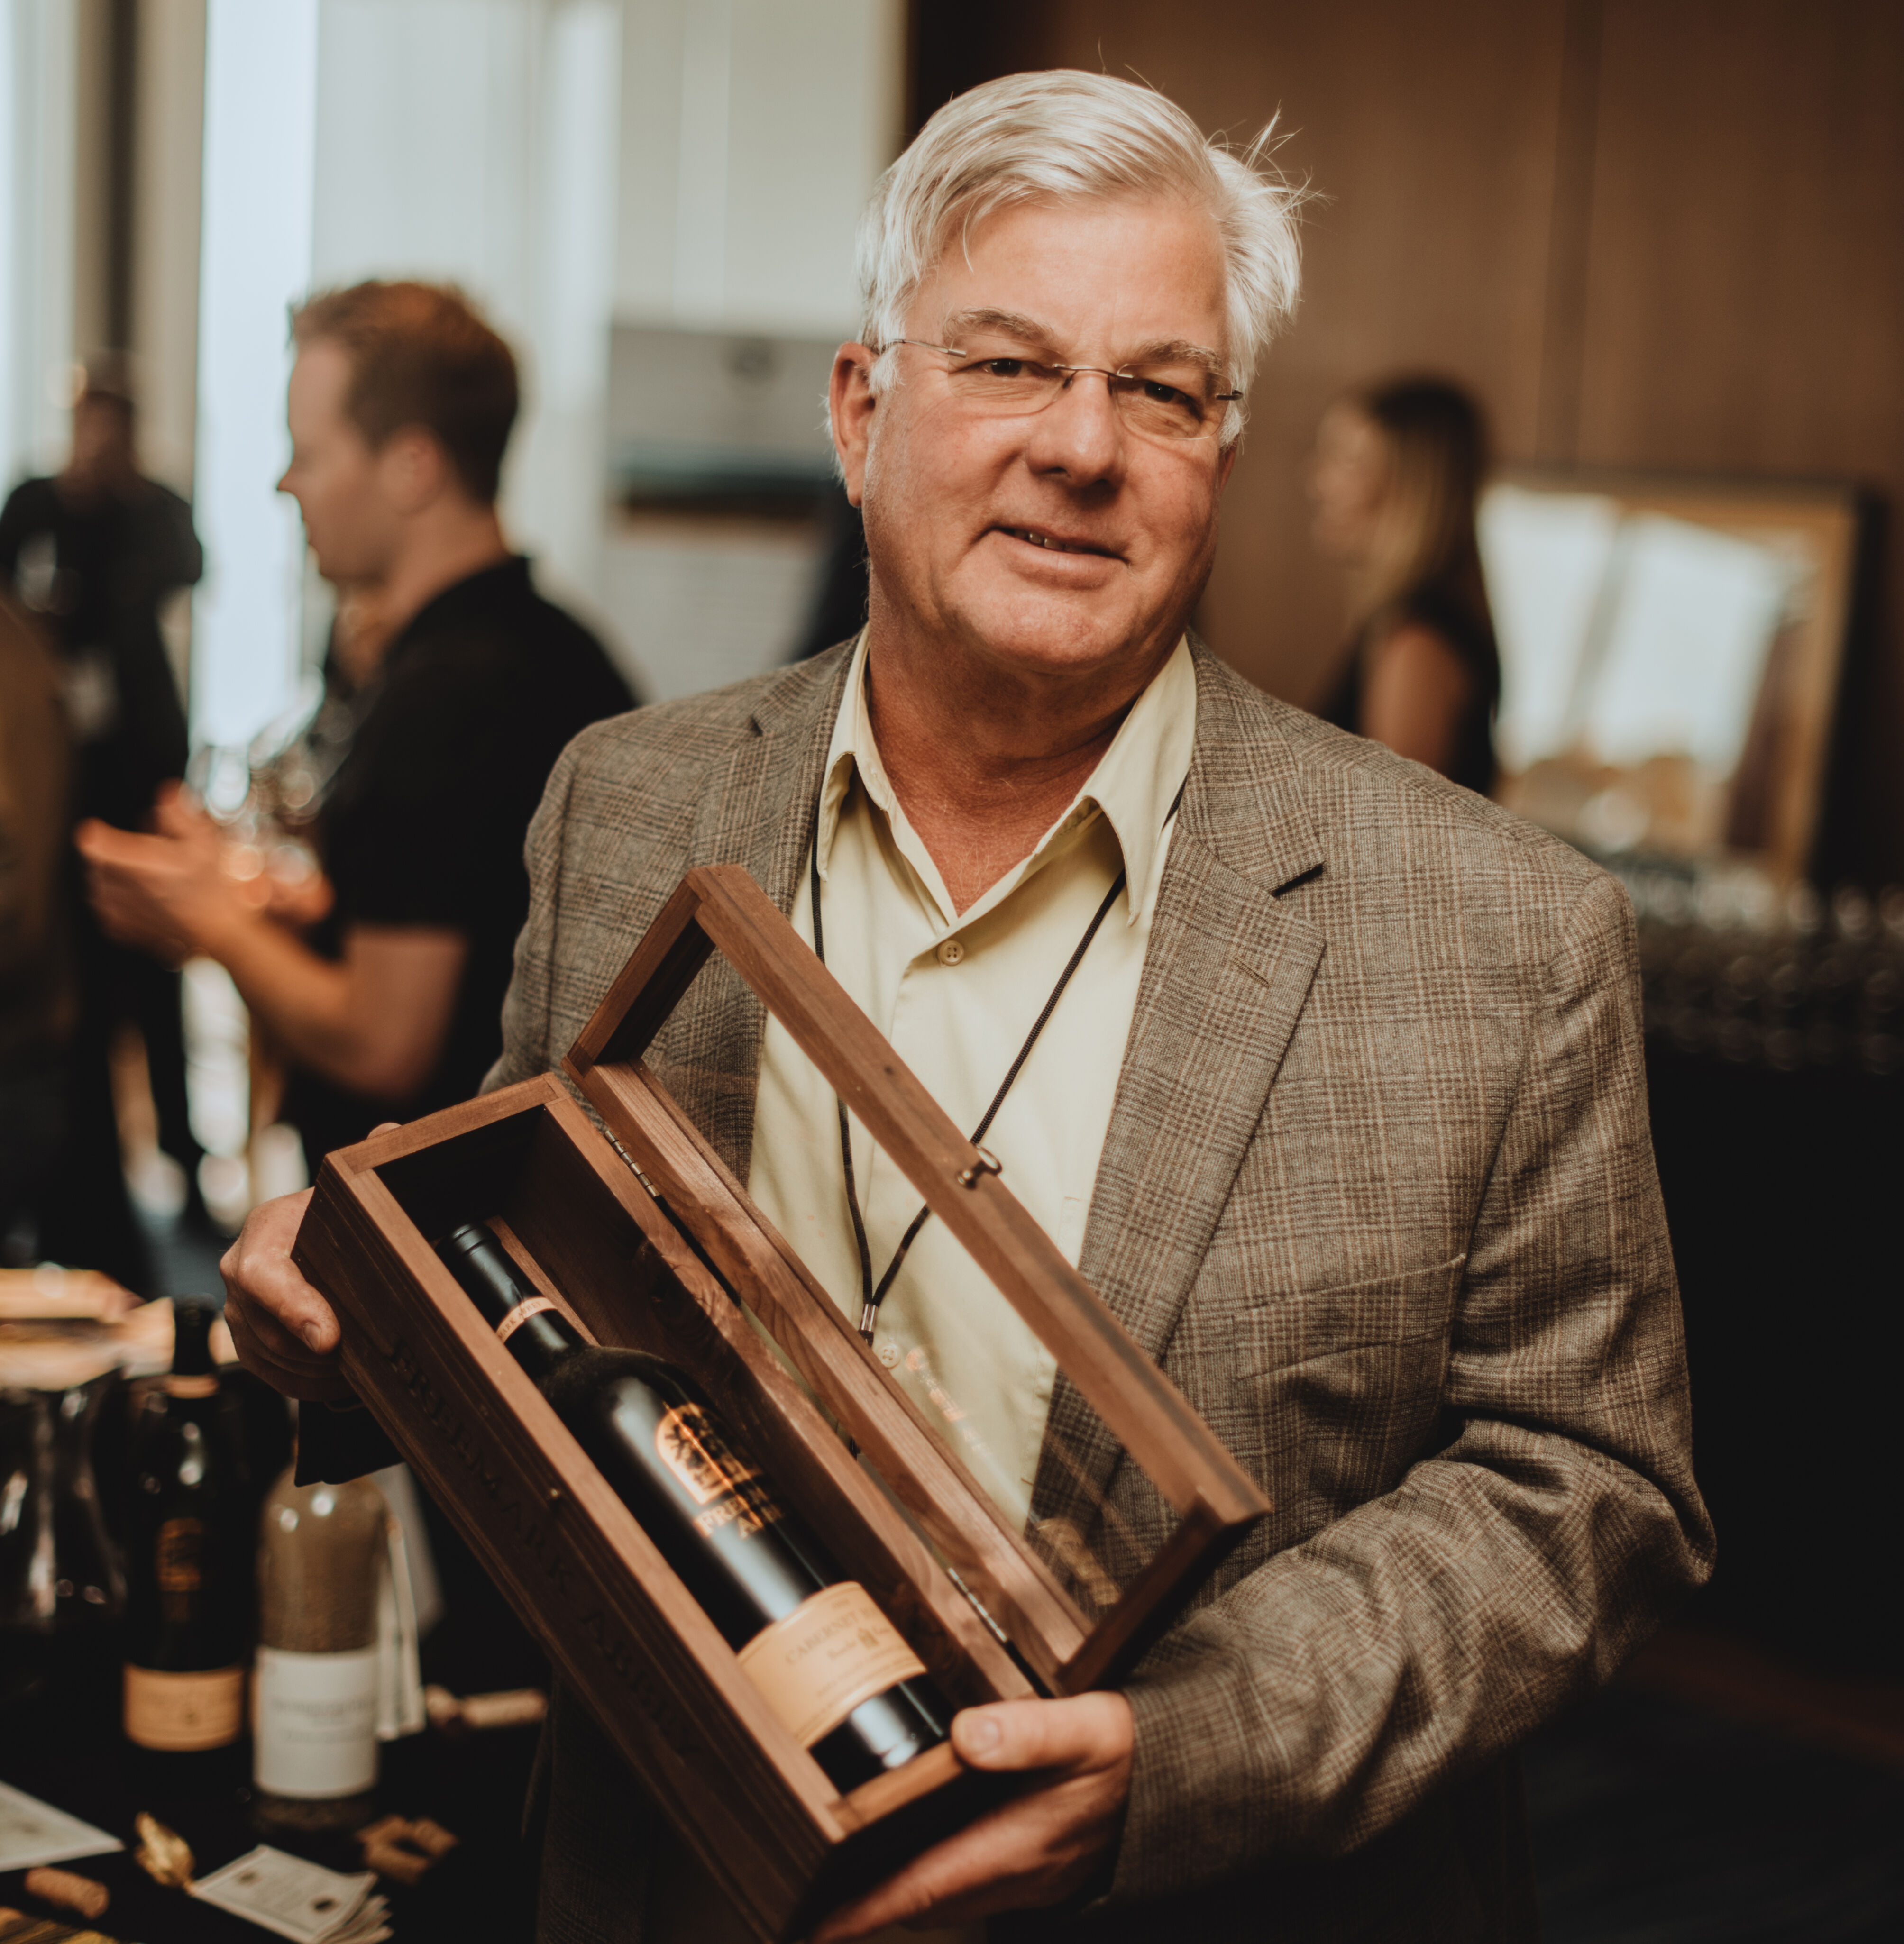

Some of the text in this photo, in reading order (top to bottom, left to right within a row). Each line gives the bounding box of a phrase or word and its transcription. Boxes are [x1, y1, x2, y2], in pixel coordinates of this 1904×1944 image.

[389, 1332, 702, 1761] FREEMARK ABBEY
[784, 1612, 860, 1665] CABERNET
